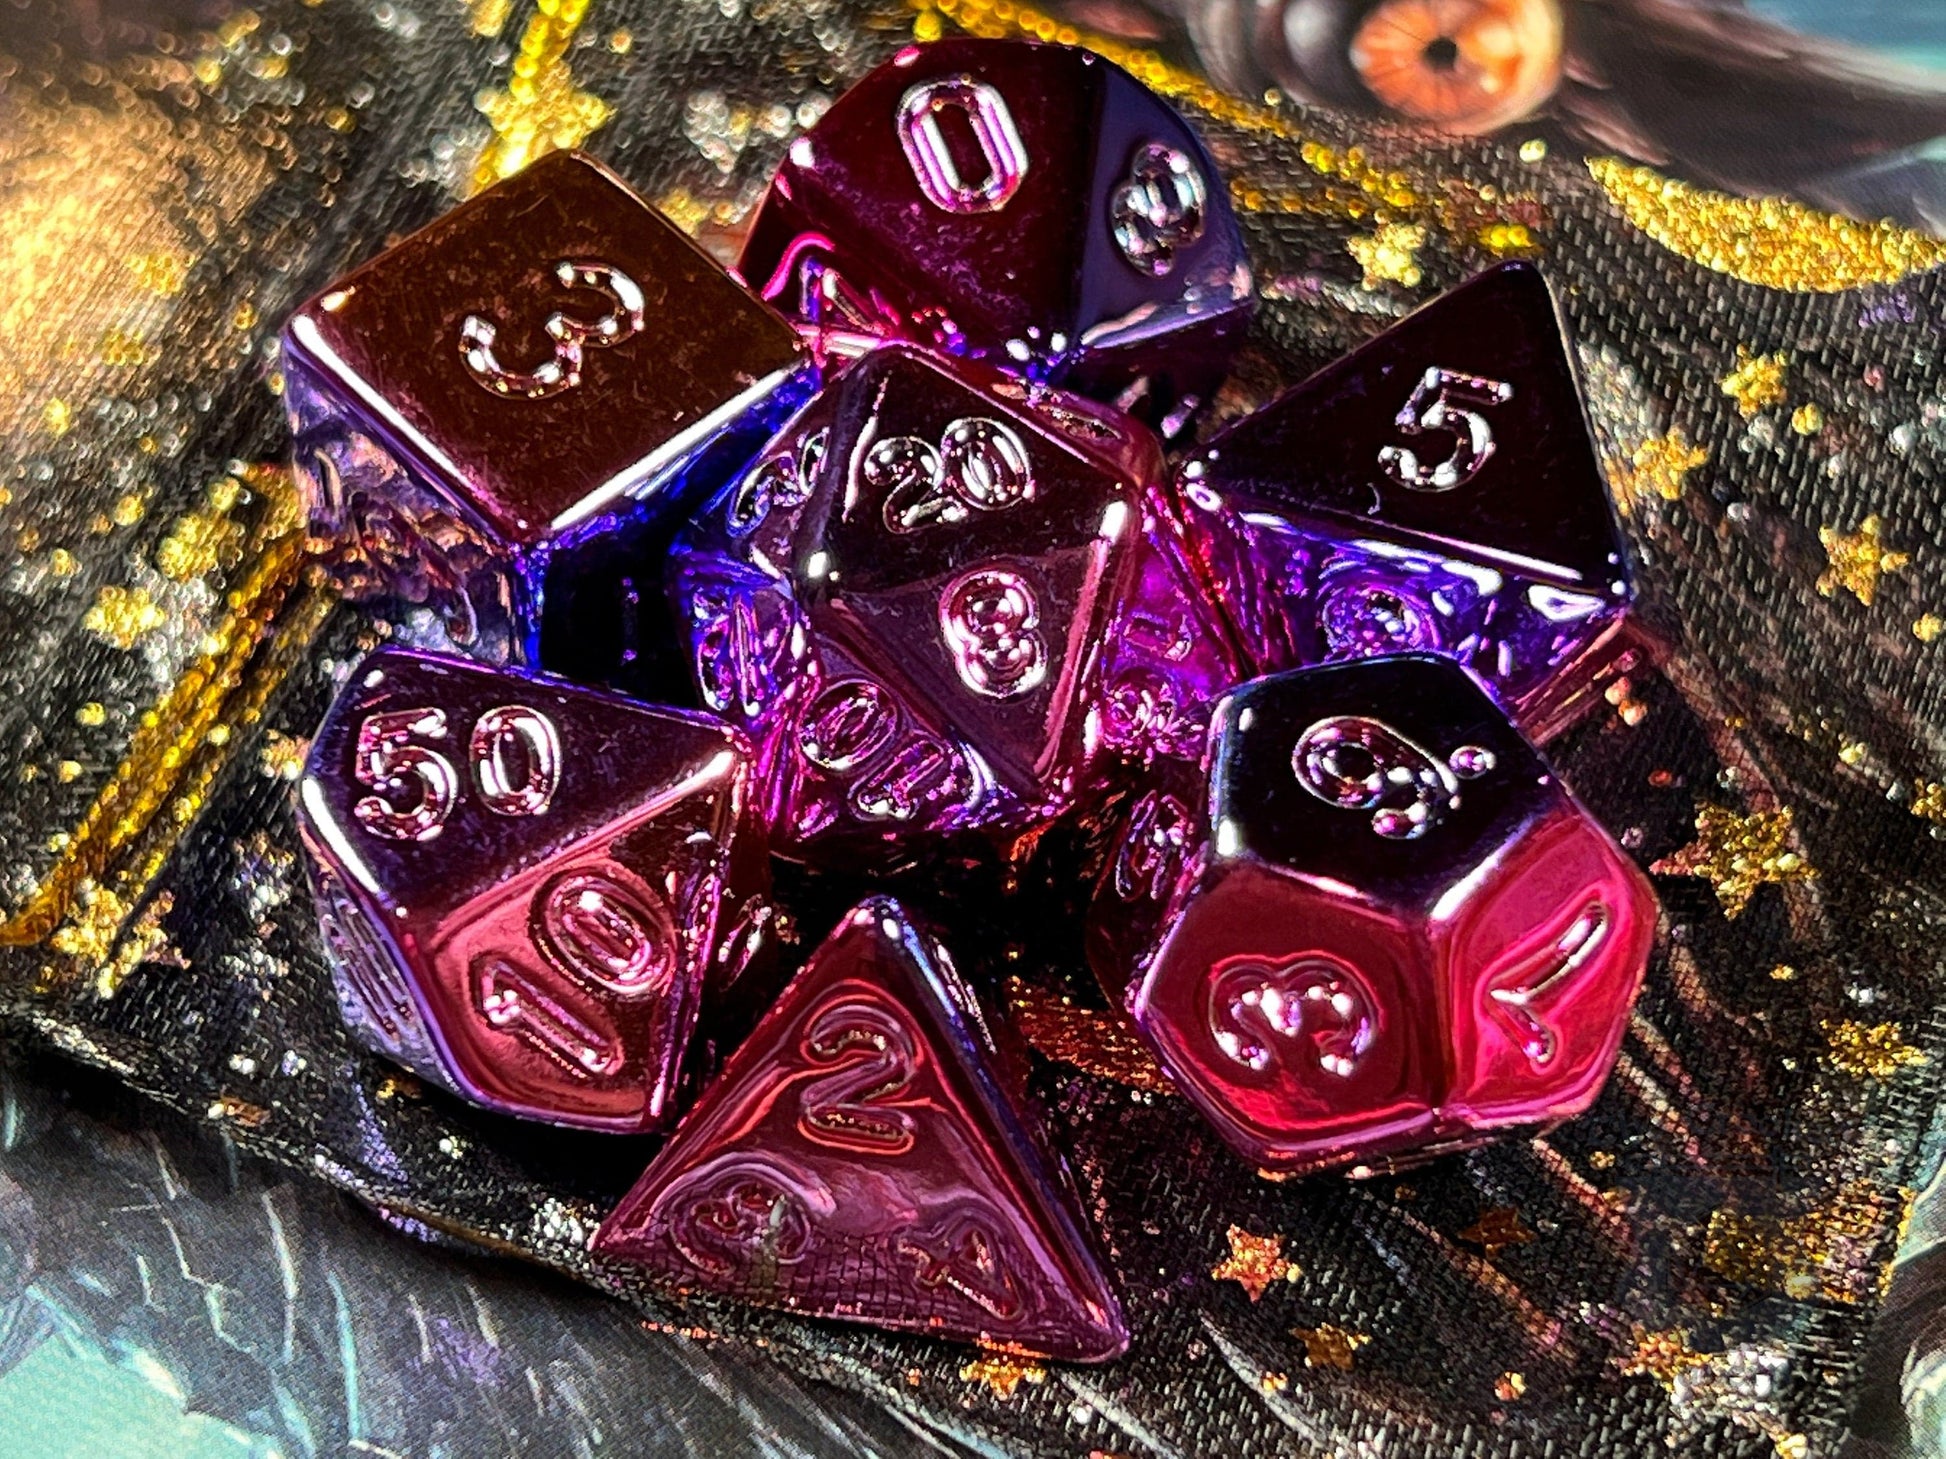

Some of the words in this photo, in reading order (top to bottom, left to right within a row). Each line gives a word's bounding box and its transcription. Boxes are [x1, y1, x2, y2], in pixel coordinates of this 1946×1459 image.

[896, 77, 1030, 214] 0
[457, 260, 647, 400] 3
[863, 417, 1037, 534] 20
[1377, 366, 1515, 493] 5
[938, 568, 1049, 699] 8
[354, 707, 562, 842] 50
[470, 870, 678, 1076] 10
[1209, 956, 1382, 1078] 3
[800, 1000, 916, 1146] 2
